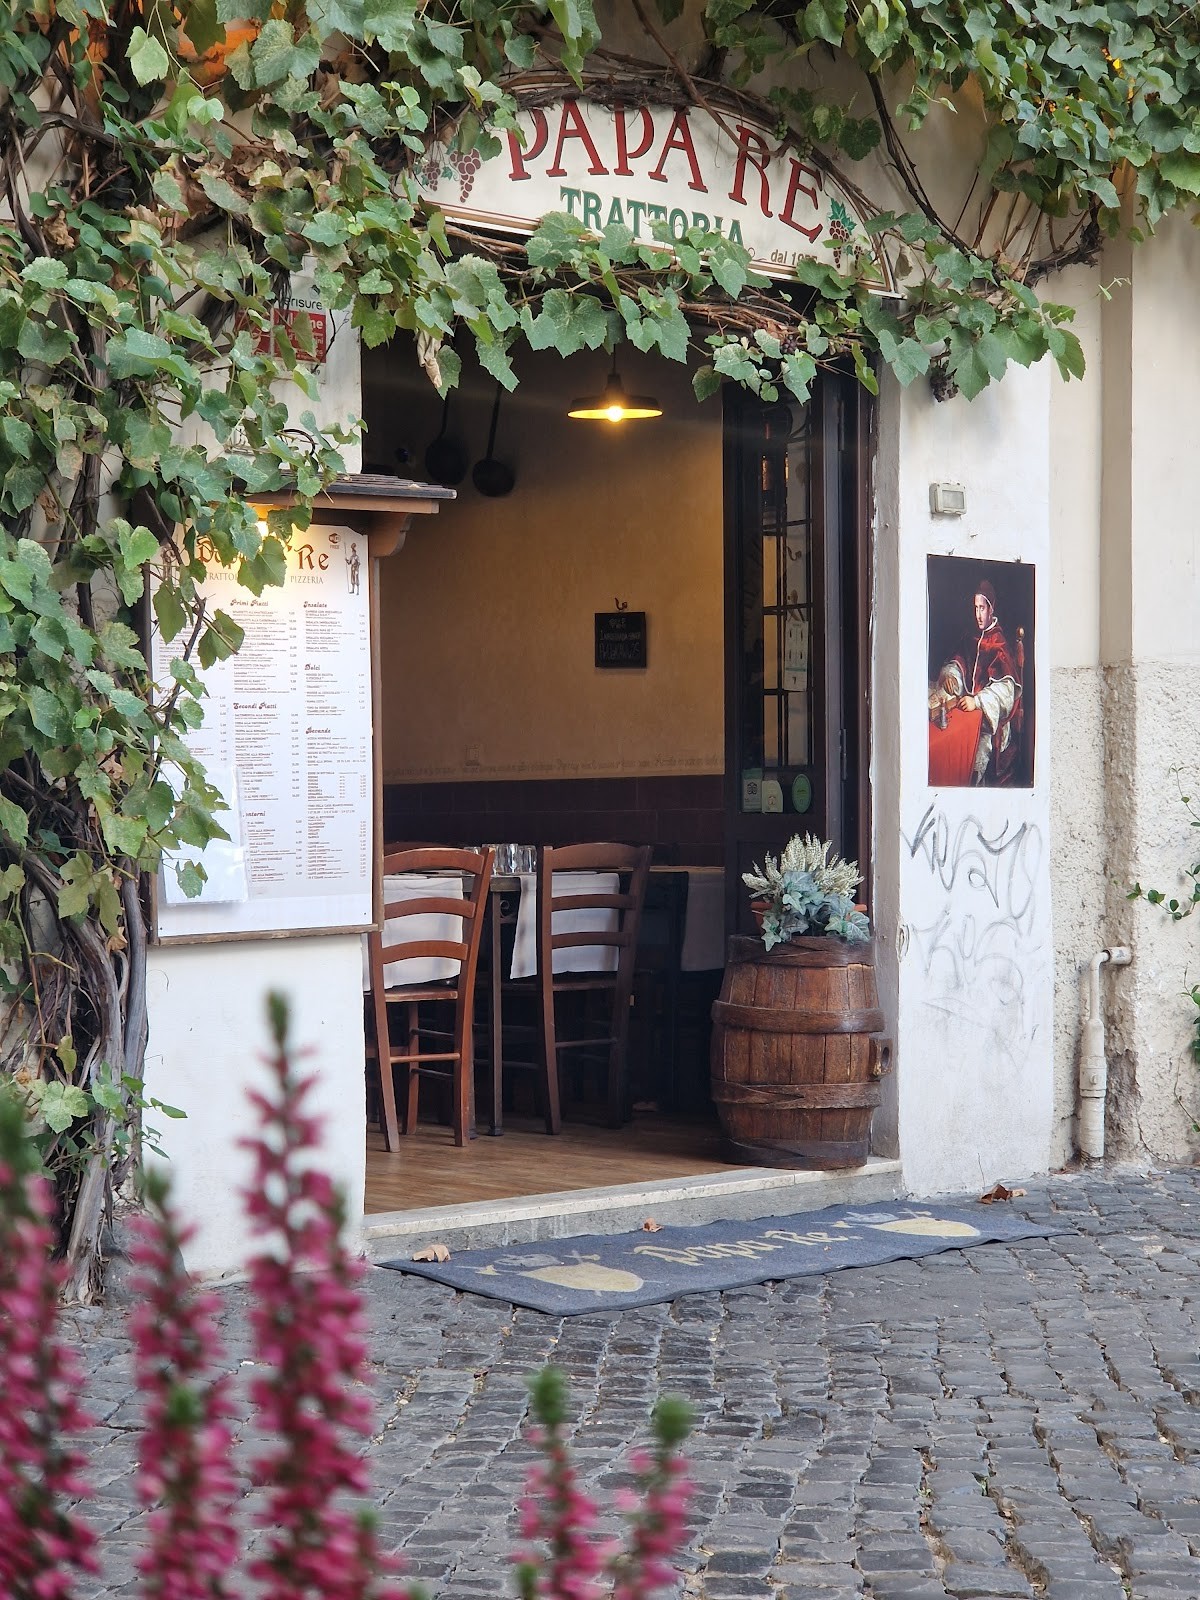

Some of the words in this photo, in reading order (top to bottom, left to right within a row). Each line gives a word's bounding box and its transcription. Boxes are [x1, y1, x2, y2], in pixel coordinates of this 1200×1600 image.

[507, 98, 709, 194] PAPA
[728, 124, 824, 244] RE
[770, 249, 788, 264] dal
[284, 297, 323, 310] erisure
[293, 543, 330, 570] Re
[206, 572, 238, 581] RATTO
[290, 575, 324, 585] PIZZERIA
[243, 810, 266, 818] ntorni
